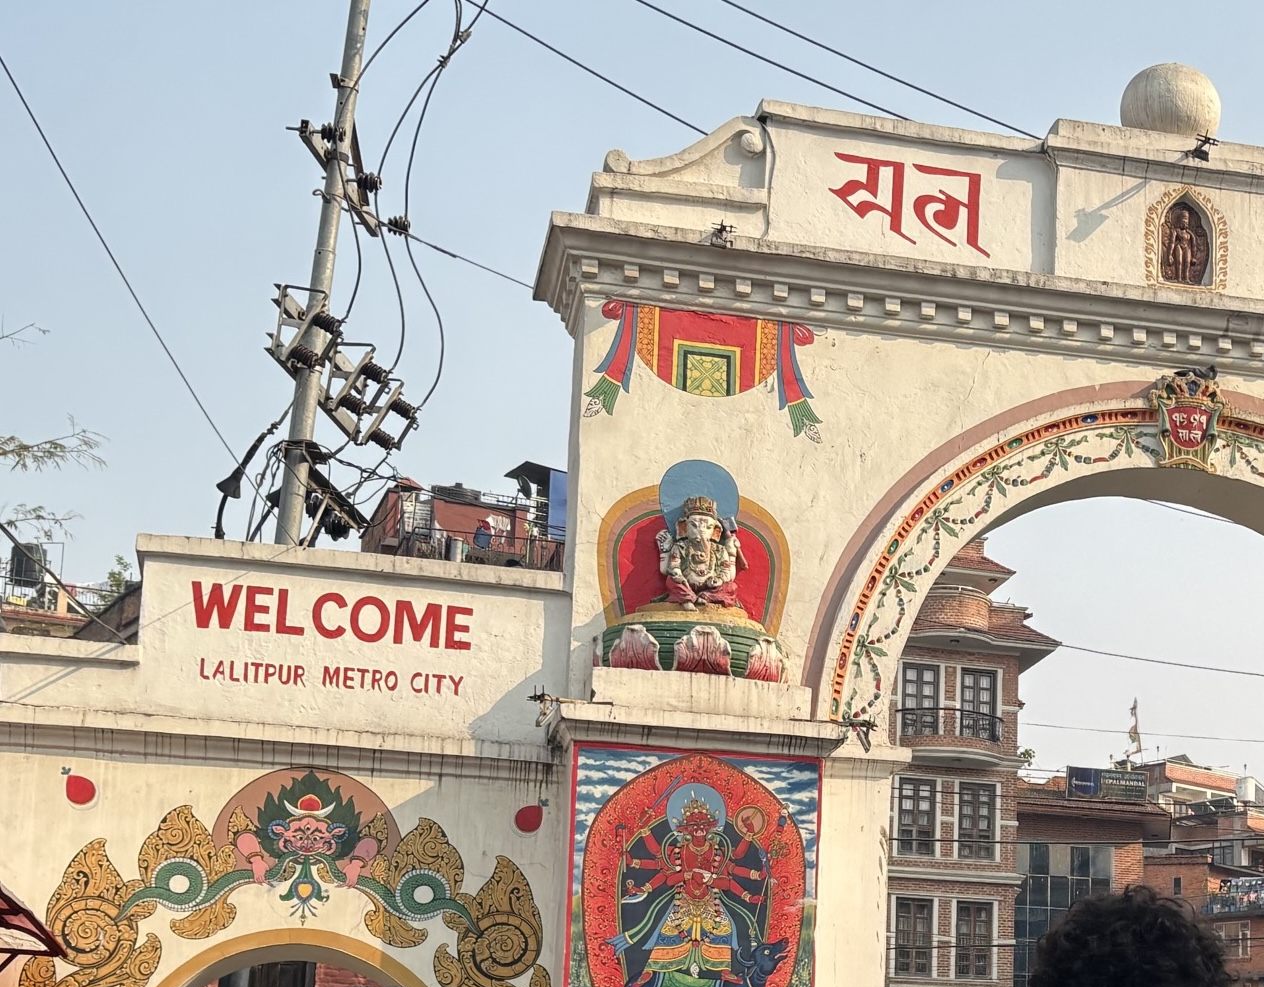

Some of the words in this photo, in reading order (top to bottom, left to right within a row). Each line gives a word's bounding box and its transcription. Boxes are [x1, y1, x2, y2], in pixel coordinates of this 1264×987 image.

[191, 580, 474, 651] WELCOME
[199, 657, 306, 687] LALITPUR
[322, 665, 399, 692] METRO
[410, 672, 465, 696] CITY
